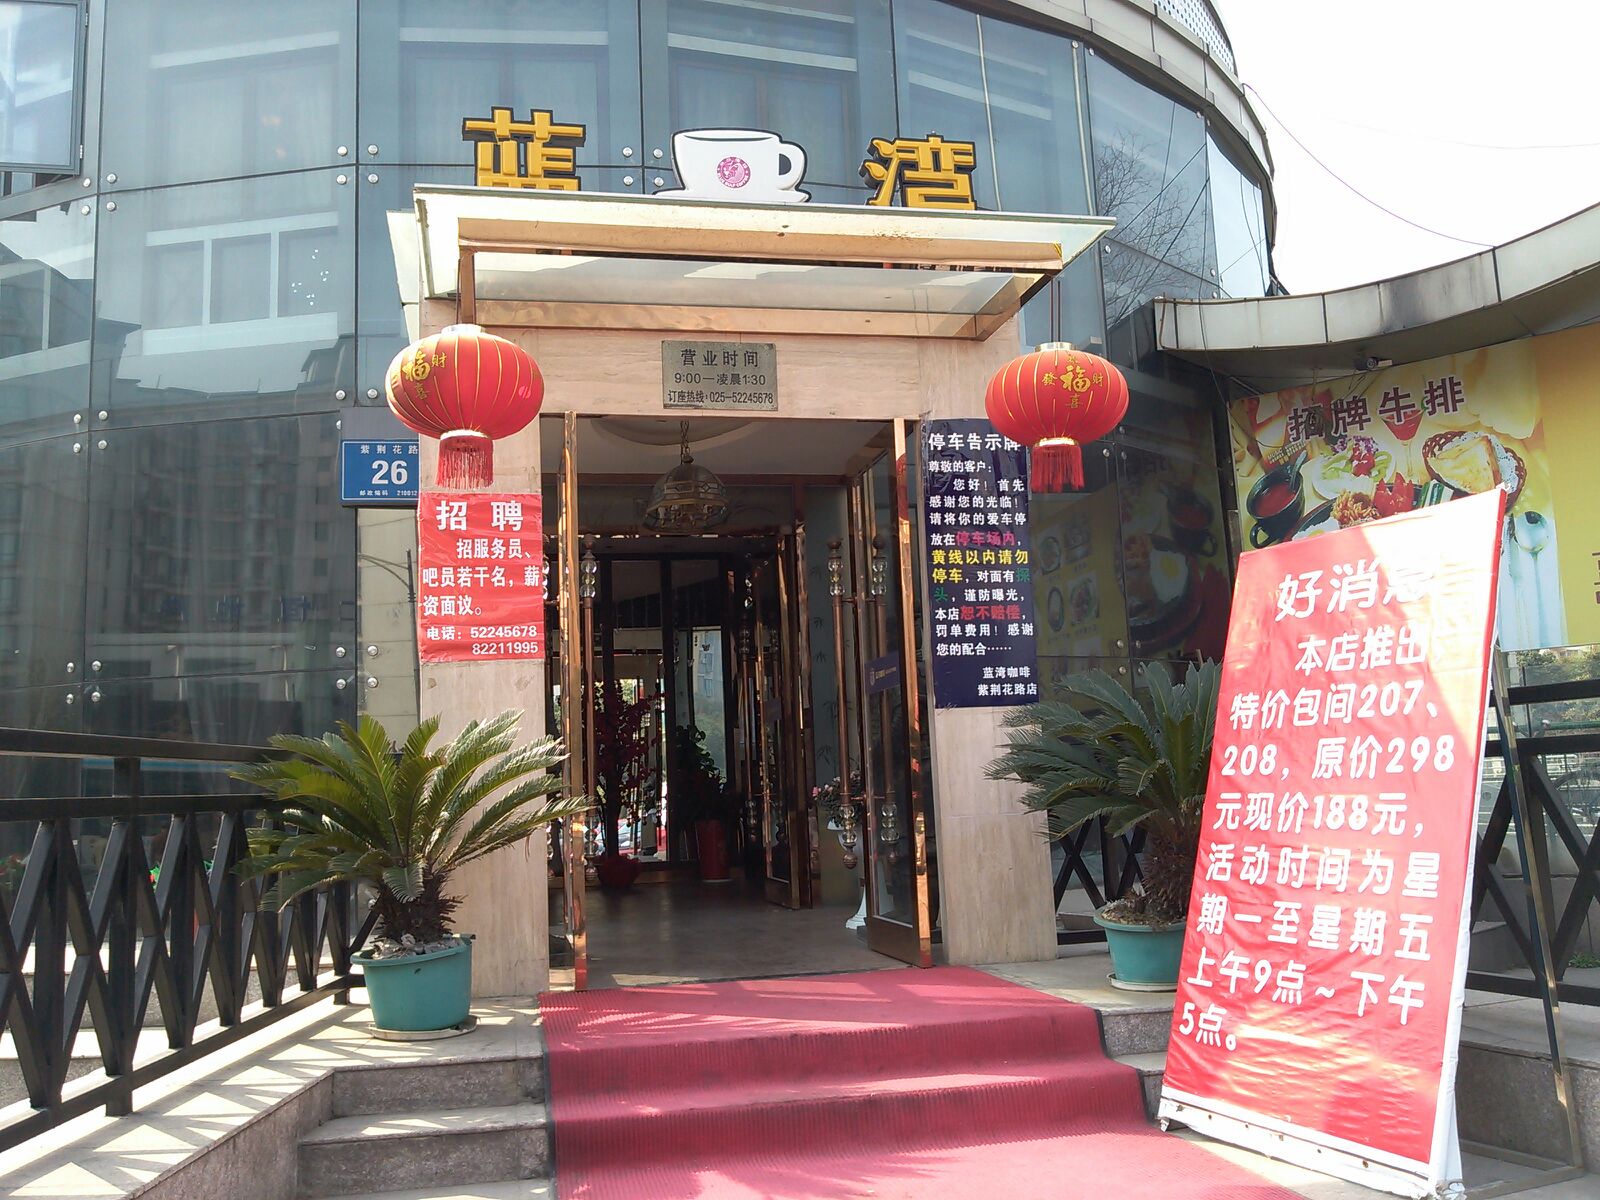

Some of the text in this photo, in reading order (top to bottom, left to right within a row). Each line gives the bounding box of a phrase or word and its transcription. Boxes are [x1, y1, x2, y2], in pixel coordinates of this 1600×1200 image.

[859, 133, 977, 211] 湾
[681, 348, 759, 368] 营业时间
[1287, 375, 1465, 444] 招牌牛排
[360, 444, 418, 455] 紫荆花路
[371, 460, 408, 485] 26
[928, 460, 993, 474] 尊敬的客户：
[359, 489, 389, 497] 邮政编码
[928, 495, 1019, 509] 感谢您的光临！
[435, 500, 524, 532] 招聘
[929, 512, 1027, 526] 请将你的爱车停
[456, 538, 532, 559] 招服务员、
[931, 549, 1029, 565] 黄线以内请勿
[422, 565, 540, 588] 吧员若干名，薪
[422, 595, 482, 616] 资面议。
[935, 605, 1026, 621] 本店恕不赔偿，
[472, 642, 539, 655] 82211995
[1295, 622, 1428, 677] 本店推出
[982, 666, 1031, 679] 蓝湾咖啡
[977, 682, 1038, 697] 紫荆花路店
[1229, 680, 1439, 731] 特价包间207、
[1213, 792, 1425, 839] 元现价188元，
[1205, 842, 1440, 898] 活动时间为星
[1196, 892, 1433, 961] 期一至星期五
[1178, 1002, 1238, 1052] 5点。
